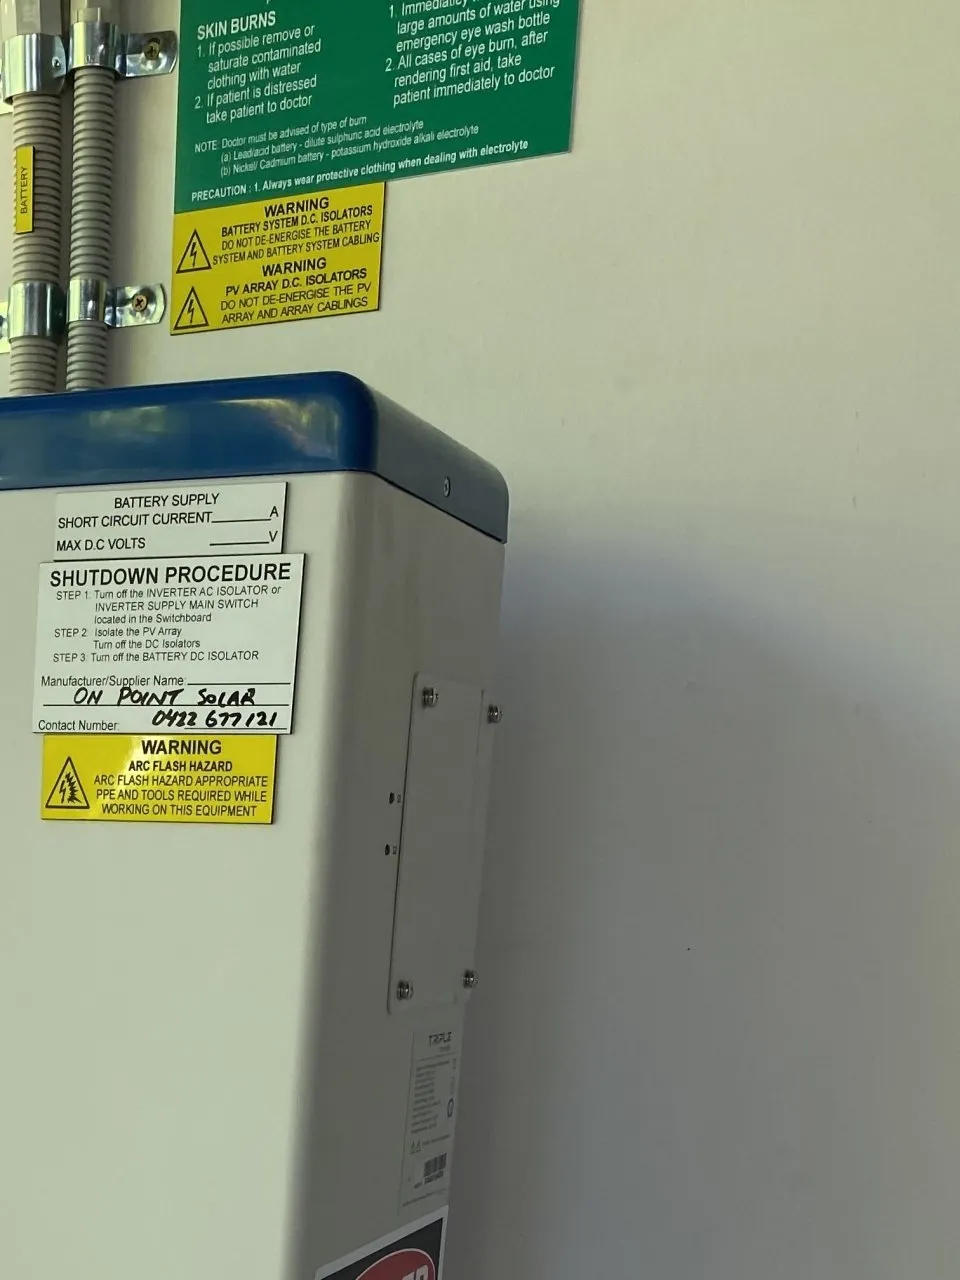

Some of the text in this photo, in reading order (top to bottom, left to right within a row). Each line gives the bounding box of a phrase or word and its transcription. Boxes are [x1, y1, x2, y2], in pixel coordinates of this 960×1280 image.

[197, 10, 276, 40] SKIN BURNS
[396, 11, 550, 53] emergency eye wash bottle
[208, 39, 321, 73] saturate contaminated
[208, 61, 301, 90] clothing with water
[394, 53, 522, 87] rendering first aid, take
[393, 65, 555, 108] patient immediately to doctor
[206, 94, 312, 124] take patient to doctor
[192, 139, 528, 201] PRECAUTION 1. Always wear protective clothing when dealing with electrolyte
[20, 166, 28, 214] BATTERY
[264, 197, 329, 218] WARNING
[222, 205, 372, 237] BATTERY SYSTEM D.C. ISOLATORS
[222, 219, 371, 251] DO NOT DE-ENERGISE THE BATTERY
[213, 233, 379, 265] SYSTEM AND BATTERY SYSTEM CABLING
[262, 257, 326, 277] WARNING
[226, 268, 367, 296] PV ARRAY D.C. ISOLATORS
[221, 282, 371, 311] DO NOT DE-ENERGISE THE PV
[222, 297, 368, 324] ARRAY AND ARRAY CABLINGS
[115, 493, 219, 509] BATTERY SUPPLY
[58, 506, 278, 529] SHORT CIRCUIT CURRENT A
[57, 531, 278, 551] MAX D.C VOLTS V
[50, 563, 291, 587] SHUTDOWN PROCEDURE
[56, 585, 282, 600] STEP Turn off the INVERTER AC ISOLATOR or
[96, 599, 258, 611] INVERTER SUPPLY MAIN SWITCH
[95, 615, 126, 624] located
[139, 614, 153, 623] the
[156, 613, 211, 623] Switchboard
[55, 627, 182, 638] STEP Isolate the PV Array
[93, 639, 200, 649] Turn off the DC Isolators
[53, 653, 78, 662] STEP
[91, 653, 110, 662] Turn
[113, 652, 124, 661] off
[126, 653, 139, 661] the
[143, 652, 188, 661] BATTERY
[190, 651, 204, 661] DC
[208, 651, 259, 661] ISOLATOR
[41, 675, 150, 688] Manufacturer/Supplier
[73, 687, 256, 706] ON POINT SOLAR
[38, 720, 119, 731] Contact Number:
[152, 710, 196, 727] 0422
[142, 740, 221, 755] WARNING
[129, 761, 232, 772] ARC FLASH HAZARD
[94, 775, 268, 787] ARC FLASH HAZARD APPROPRIATE
[96, 789, 267, 802] PPE AND TOOLS REQUIRED WHILE
[102, 804, 257, 816] WORKING ON THIS EQUIPMENT
